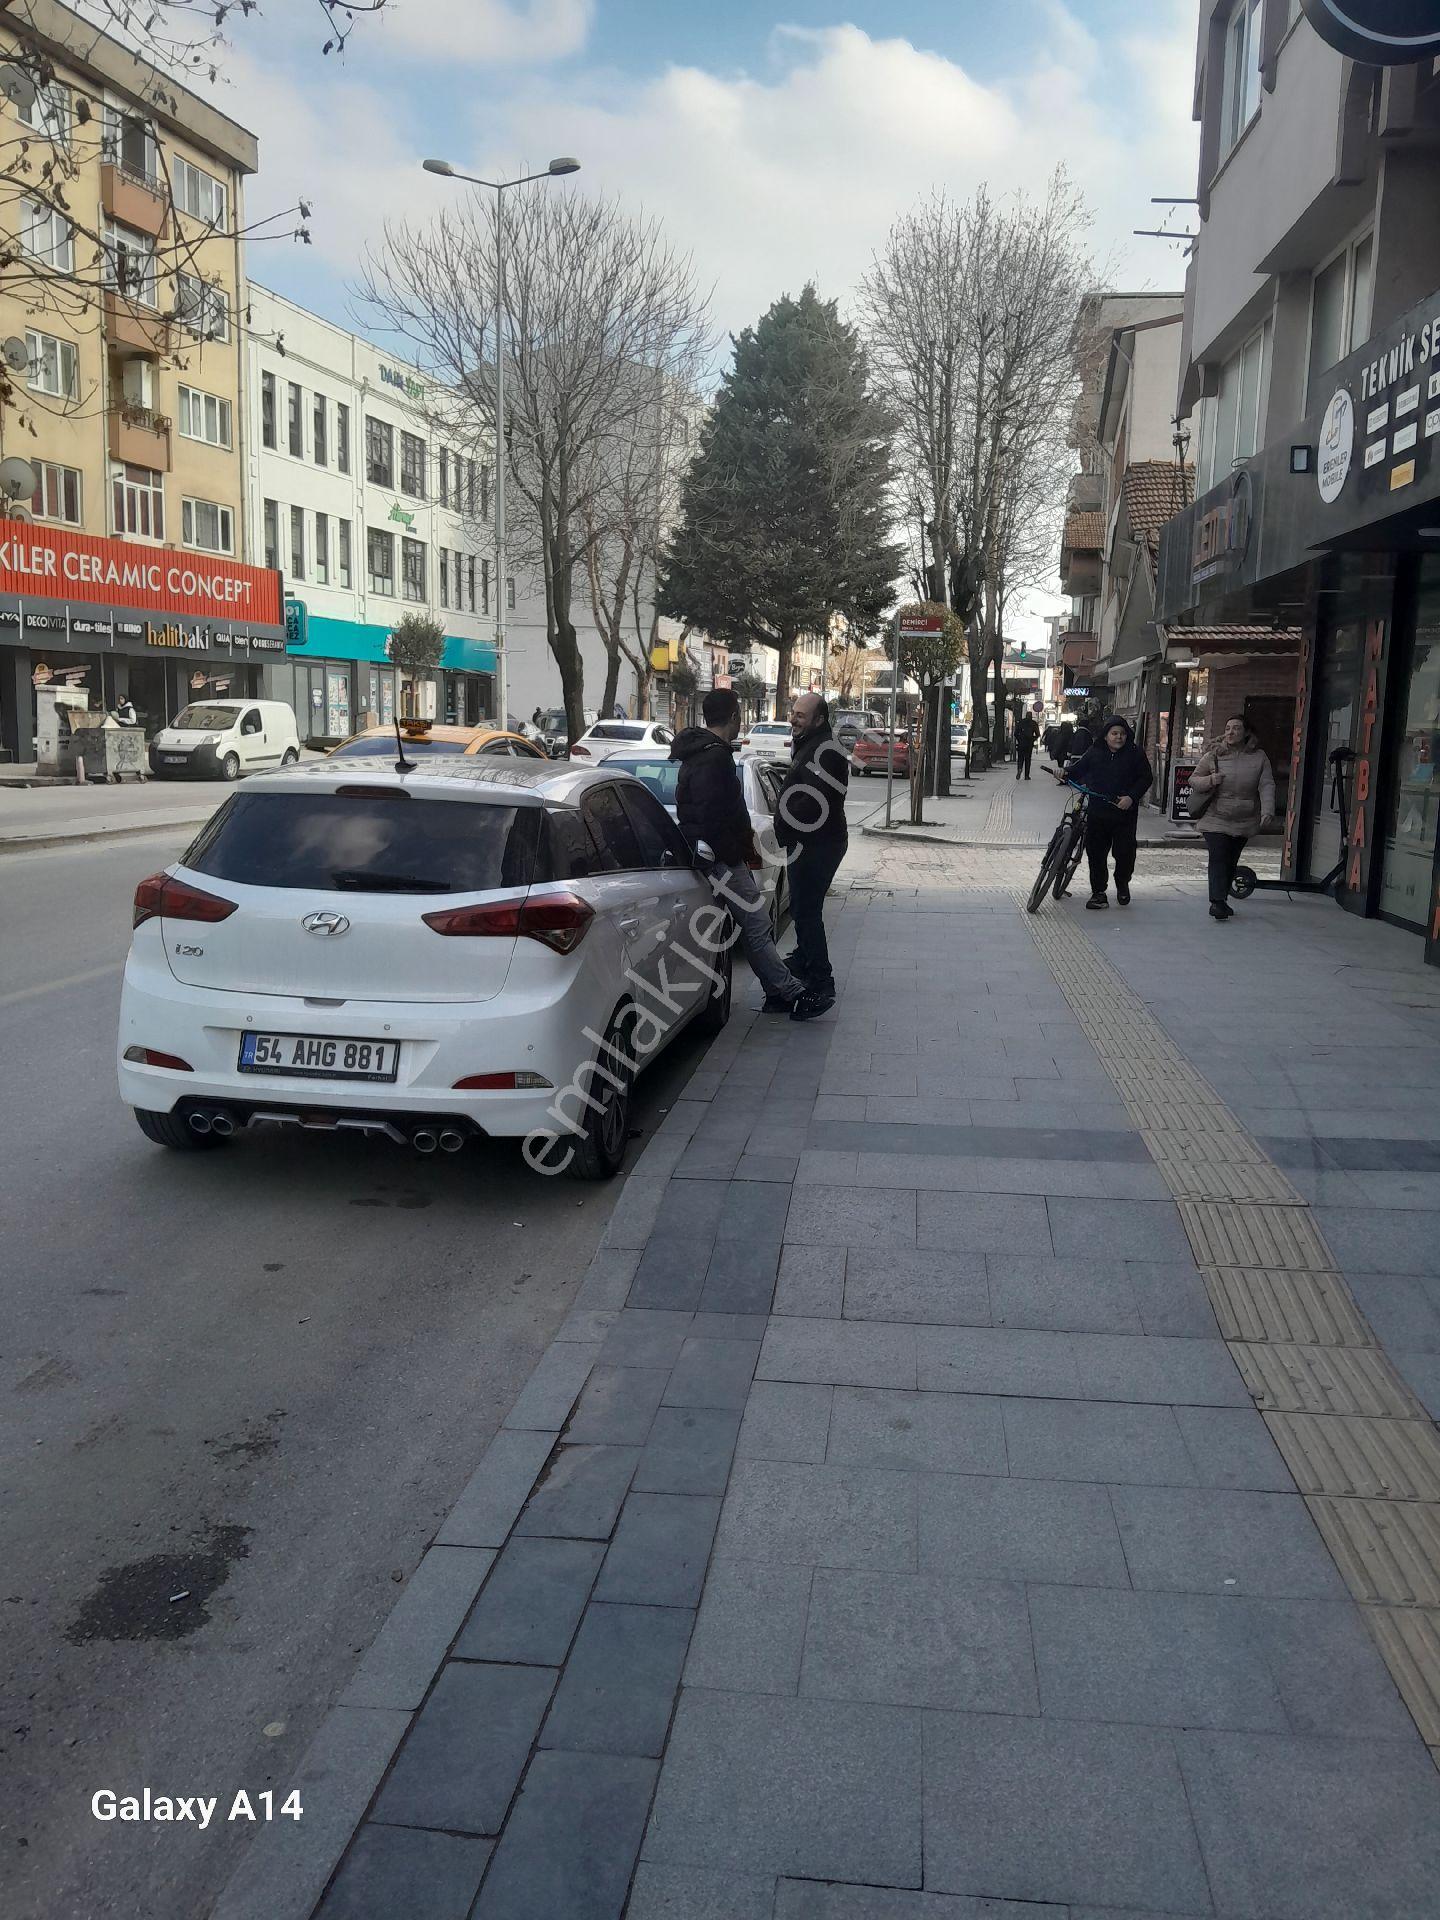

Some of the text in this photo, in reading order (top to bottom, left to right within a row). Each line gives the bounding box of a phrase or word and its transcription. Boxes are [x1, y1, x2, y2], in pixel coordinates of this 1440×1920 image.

[1361, 333, 1415, 401] TEKNİK
[0, 534, 252, 604] KİLER CERAMIC CONCEPT
[175, 943, 204, 957] i20
[255, 1037, 282, 1064] 54
[292, 1039, 336, 1067] AHG
[343, 1043, 385, 1071] 881
